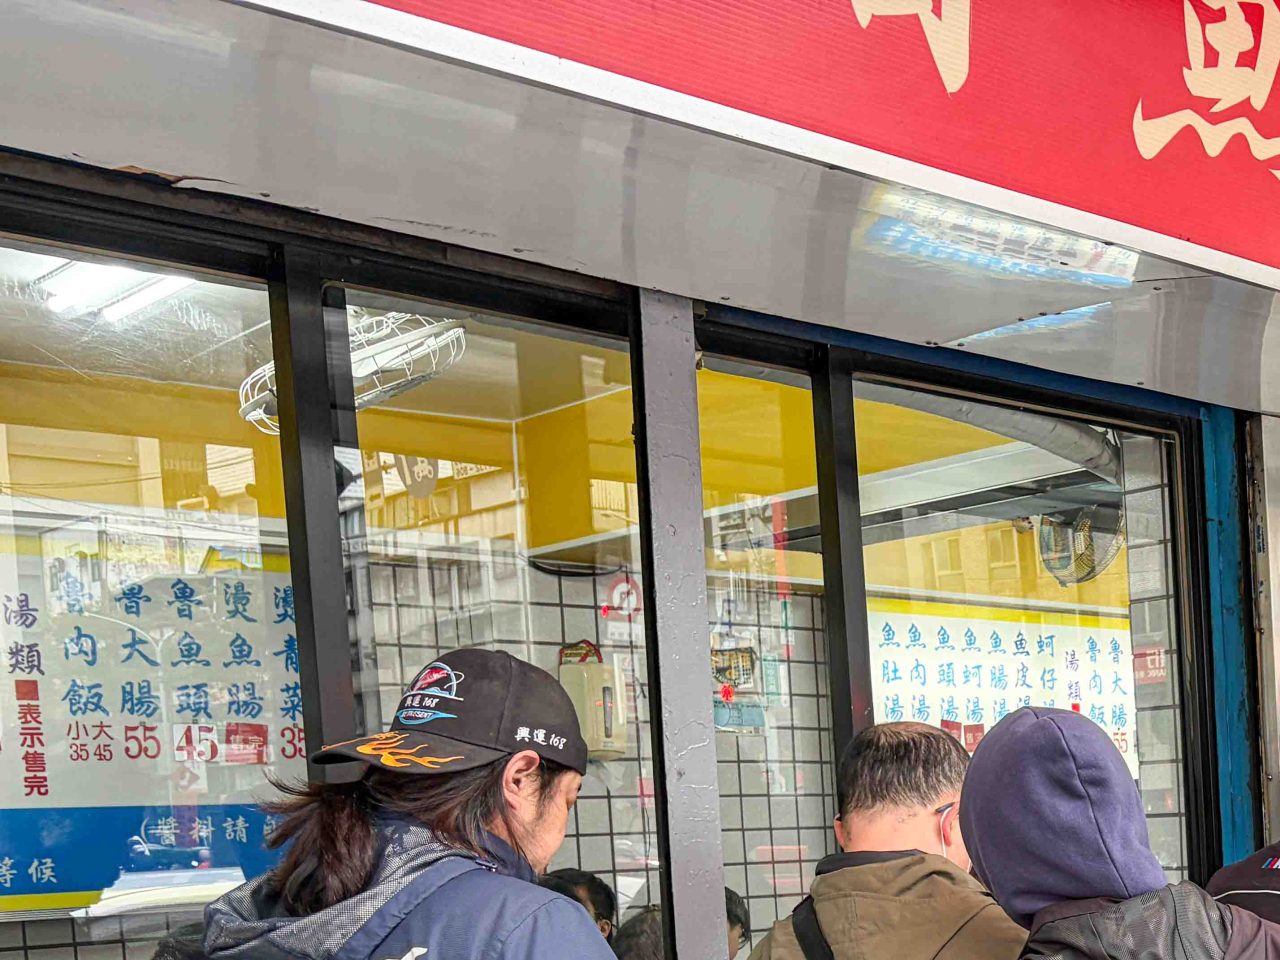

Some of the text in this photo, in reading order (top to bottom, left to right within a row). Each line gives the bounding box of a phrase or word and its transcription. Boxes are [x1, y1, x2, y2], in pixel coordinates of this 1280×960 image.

[3, 593, 45, 676] 湯類
[61, 572, 112, 717] 魯肉飯
[114, 583, 162, 719] 魯大腸
[167, 578, 213, 719] 魯魚頭
[223, 582, 265, 719] 燙魚腸
[879, 622, 904, 721] 魚肚湯
[905, 623, 932, 721] 魚肉湯
[935, 625, 960, 721] 魚頭湯
[961, 627, 985, 723] 魚蚵湯
[1065, 650, 1082, 702] 湯類
[1085, 636, 1107, 727] 魯肉飯
[1108, 637, 1128, 728] 魯大腸
[17, 703, 49, 797] 表示售完
[67, 721, 113, 741] 小 大
[69, 744, 113, 762] 35 45
[124, 725, 162, 760] 55
[175, 724, 219, 762] 45
[515, 726, 567, 750] 興運 168
